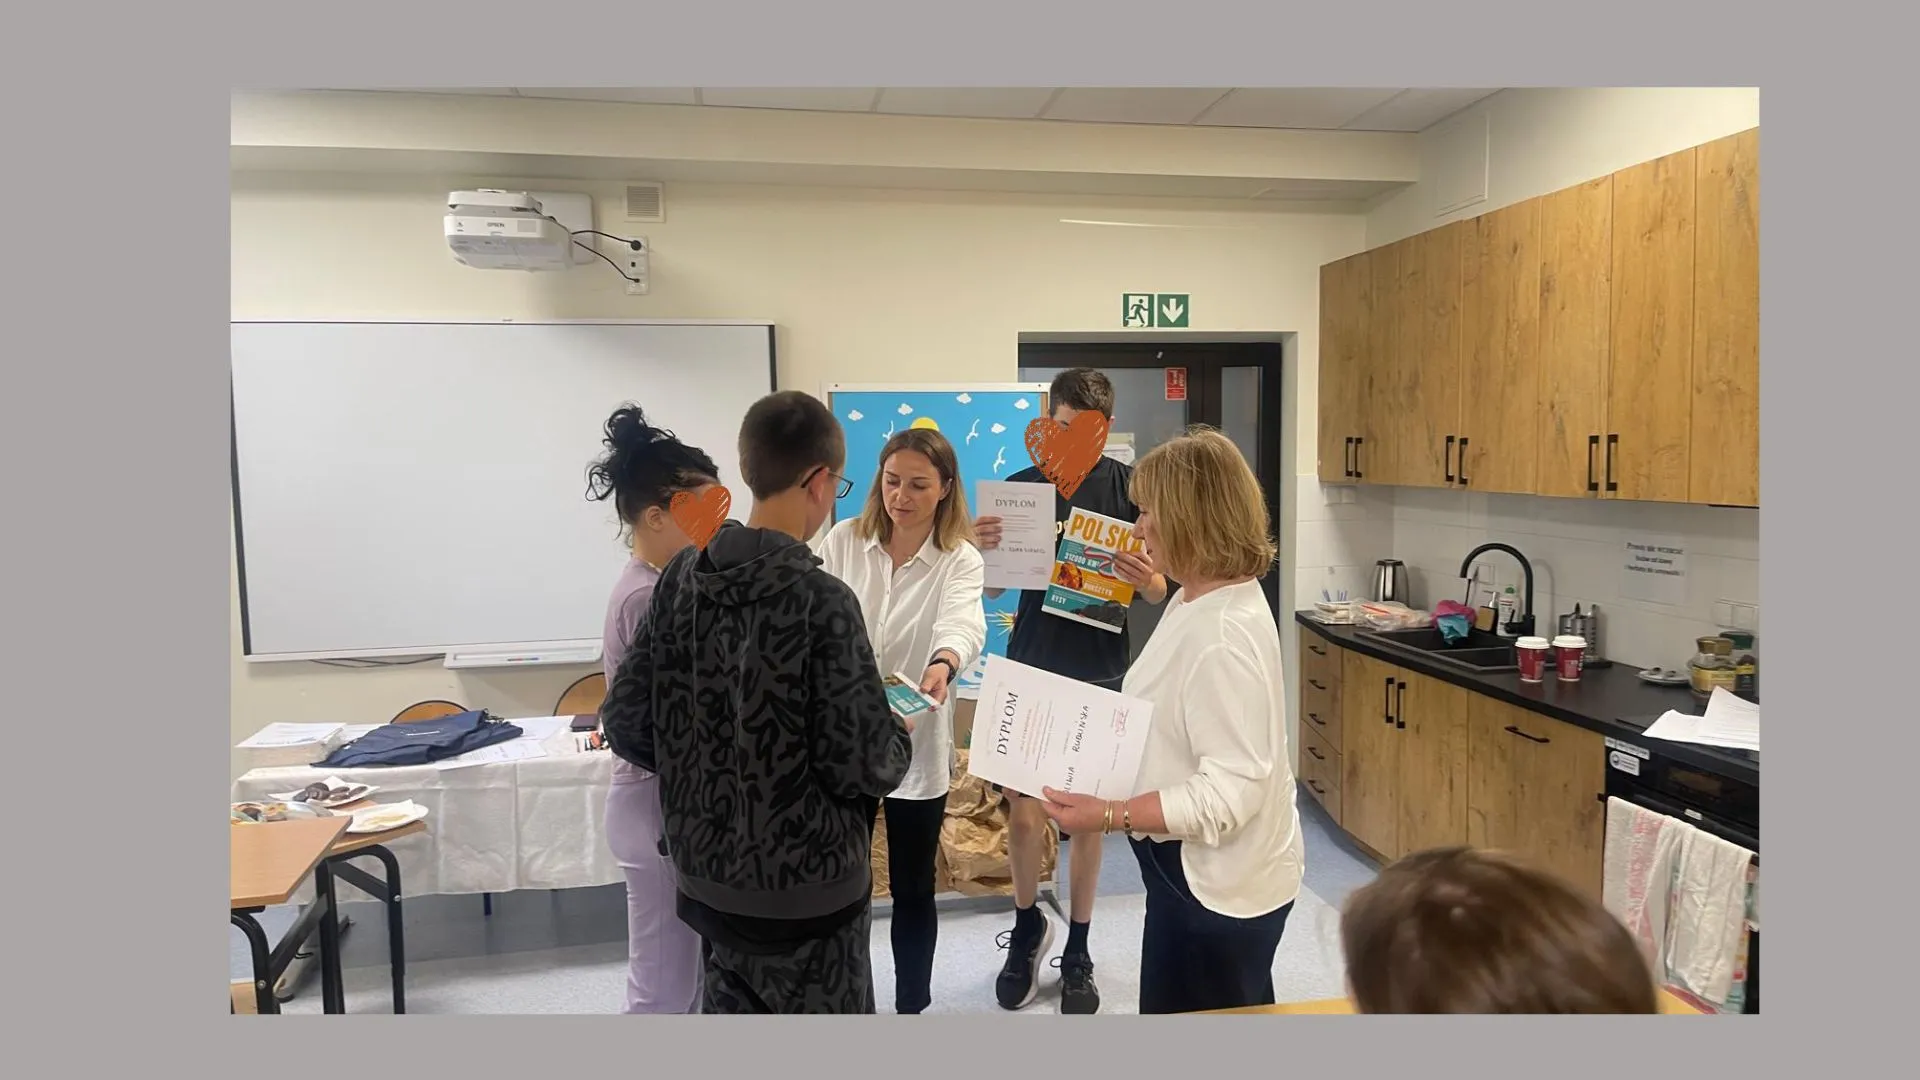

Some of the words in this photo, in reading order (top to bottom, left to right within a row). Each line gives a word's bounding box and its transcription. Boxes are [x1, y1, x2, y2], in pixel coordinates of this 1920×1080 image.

[995, 498, 1036, 508] DYPLOM
[1070, 513, 1142, 553] POLSKA
[996, 692, 1019, 755] DYPLOM
